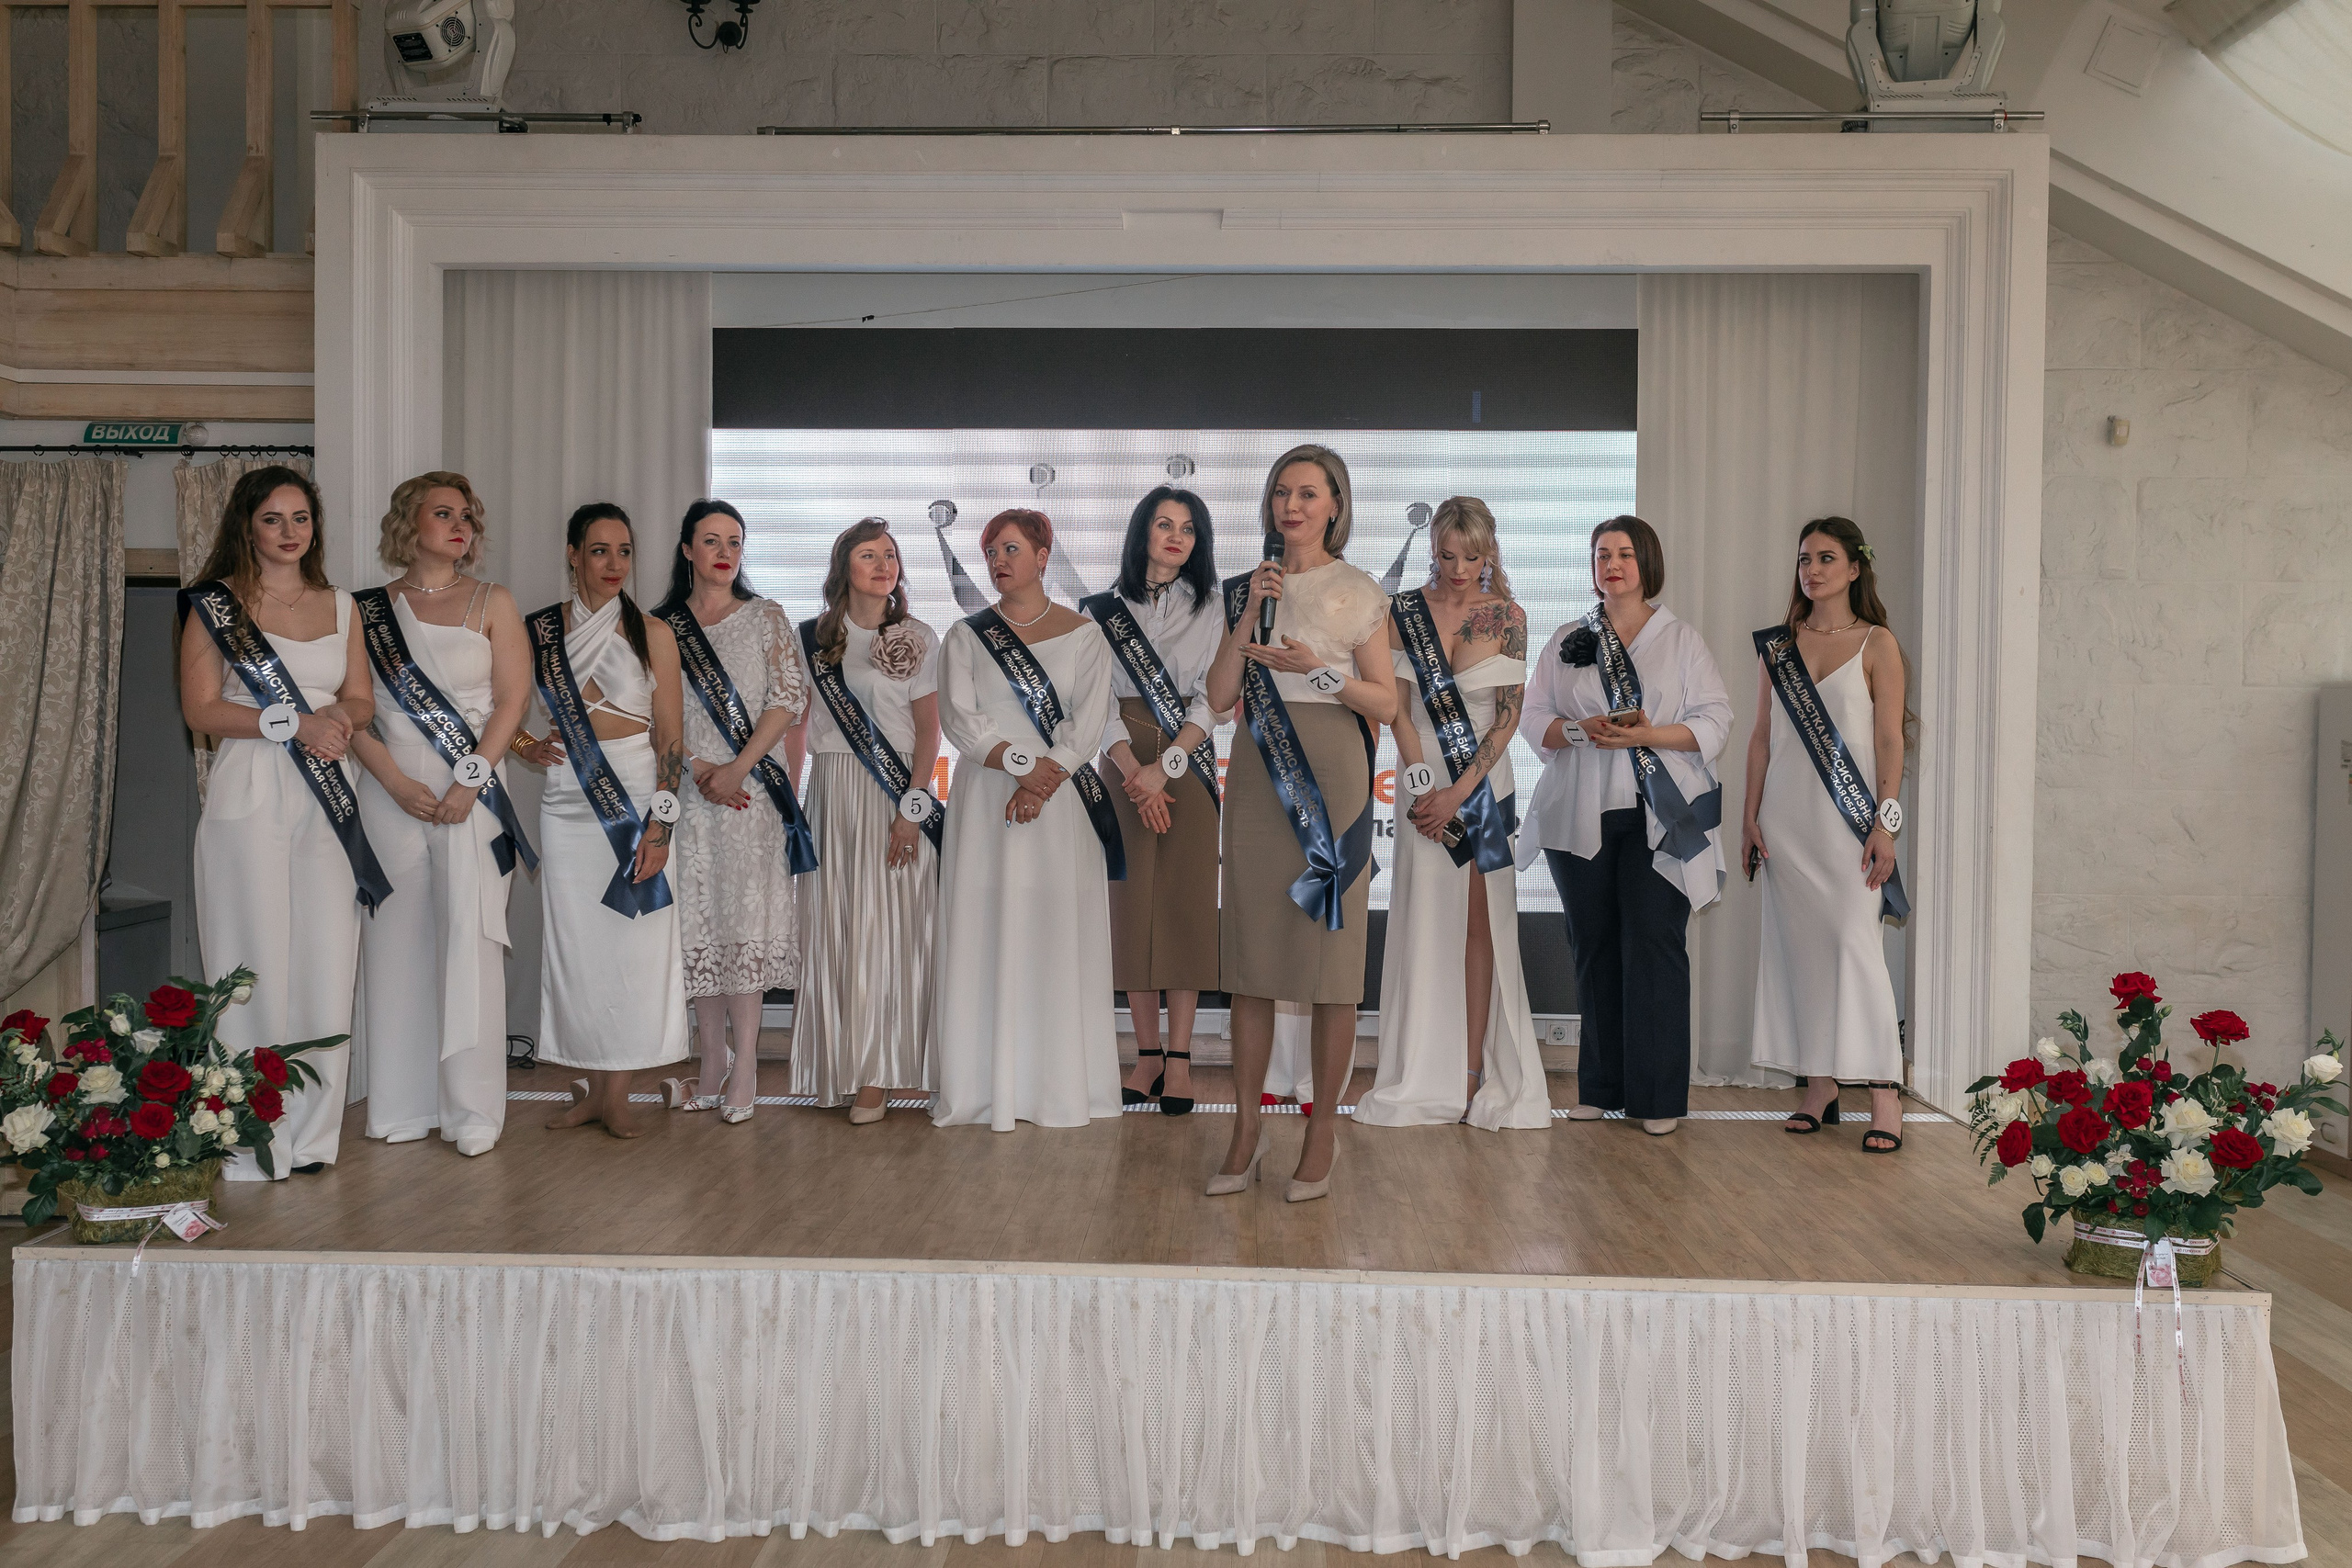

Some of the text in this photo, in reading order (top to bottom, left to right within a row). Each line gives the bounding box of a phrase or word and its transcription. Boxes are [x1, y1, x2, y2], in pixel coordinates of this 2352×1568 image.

[92, 425, 169, 442] ВЫХОД
[368, 627, 463, 761] НОВОСИБИРСК И НОВОСИБИРСКАЯ
[378, 624, 467, 747] ФИНАЛИСТКА МИССИС
[678, 640, 710, 690] НОВОСИБИРСК
[705, 687, 714, 696] И
[687, 636, 729, 703] ФИНАЛИСТКА
[725, 701, 750, 742] МИССИ
[1001, 651, 1039, 706] НОВОСИБИРСК
[1035, 705, 1042, 714] И
[1012, 649, 1056, 720] ФИНАЛИСТКА
[1120, 643, 1158, 697] НОВОСИБИРСК
[1130, 638, 1173, 709] ФИНАЛИСТКА
[1309, 670, 1340, 691] 12
[1403, 617, 1464, 775] НОВОСИБИРСК И НОВОСИБИРСКАЯ ОБЛАС
[1413, 614, 1446, 691] ФИНАЛИСТКА
[1440, 690, 1464, 735] МИССИС
[268, 716, 289, 729] 1
[549, 645, 629, 822] ФИНАЛИСТКА МИССИС БИЗНЕС
[820, 680, 856, 734] НОВОСИБИРСК
[852, 733, 859, 741] И
[827, 675, 908, 788] ФИНАЛИСТКА МИССИС
[1566, 726, 1585, 744] 11
[466, 761, 480, 780] 2
[557, 706, 563, 715] И
[594, 786, 617, 827] ОБЛАСТЬ
[1169, 754, 1182, 770] 8
[1250, 698, 1290, 783] НОВОСИБИРСКАЯ
[1286, 783, 1310, 828] ОБЛАСТЬ
[1265, 706, 1297, 768] МИССИС
[1292, 769, 1323, 822] БИЗНЕС
[1777, 666, 1868, 833] НОВОСИБИРСК И НОВОСИБИРСКАЯ ОБЛАСТЬ
[1785, 661, 1872, 827] ФИНАЛИСТКА МИССИС БИЗНЕ
[322, 782, 344, 823] ОБЛАСТЬ
[325, 767, 354, 817] БИЗНЕС
[659, 798, 673, 815] 3
[911, 797, 922, 815] 5
[1407, 769, 1430, 790] 10
[1882, 802, 1900, 828] 13
